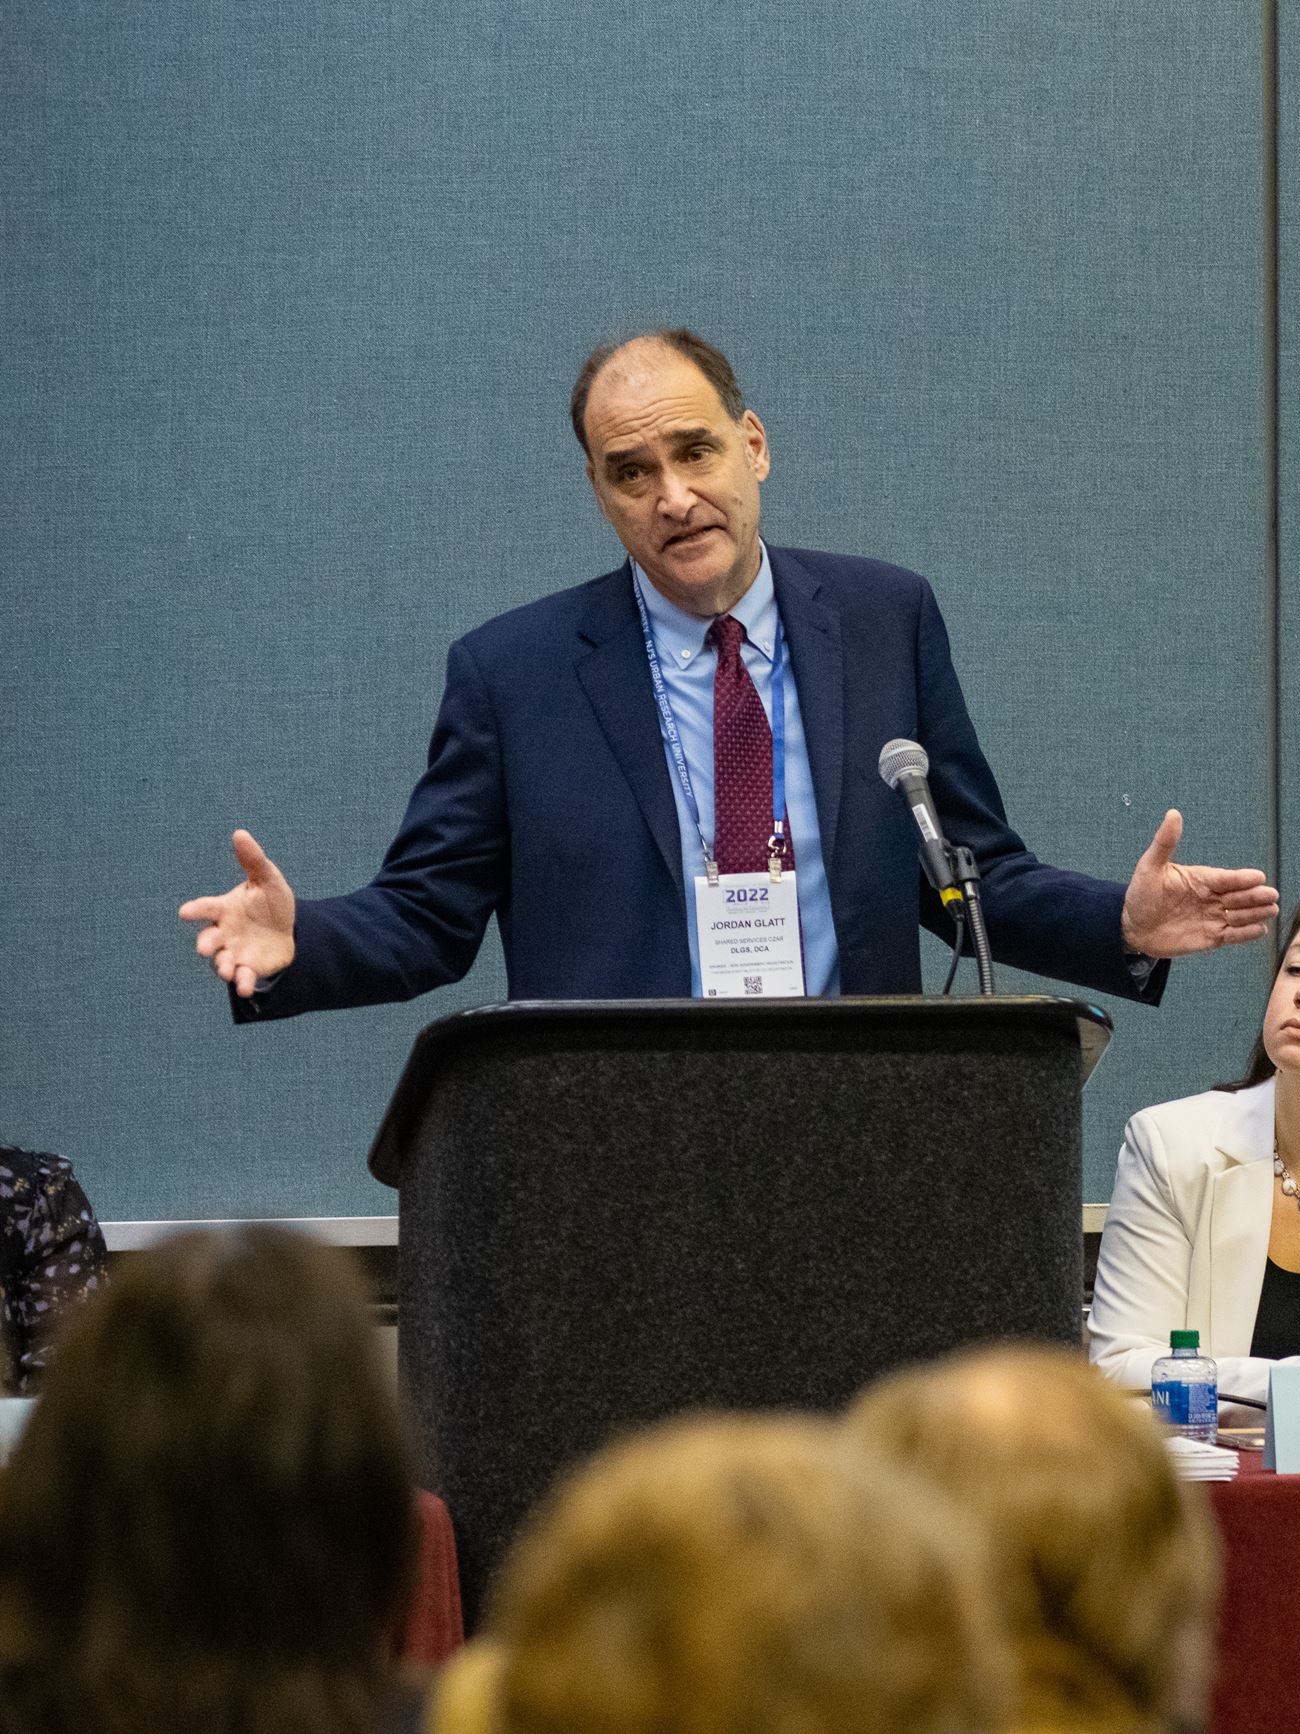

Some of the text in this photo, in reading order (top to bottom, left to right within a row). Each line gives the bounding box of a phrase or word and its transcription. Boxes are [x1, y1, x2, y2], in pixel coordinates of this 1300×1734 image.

[650, 660, 664, 693] URBAN
[658, 692, 677, 742] RESEARCH
[672, 740, 694, 798] UNIVERSITY
[726, 888, 769, 903] 2022
[710, 918, 785, 931] JORDAN GLATT
